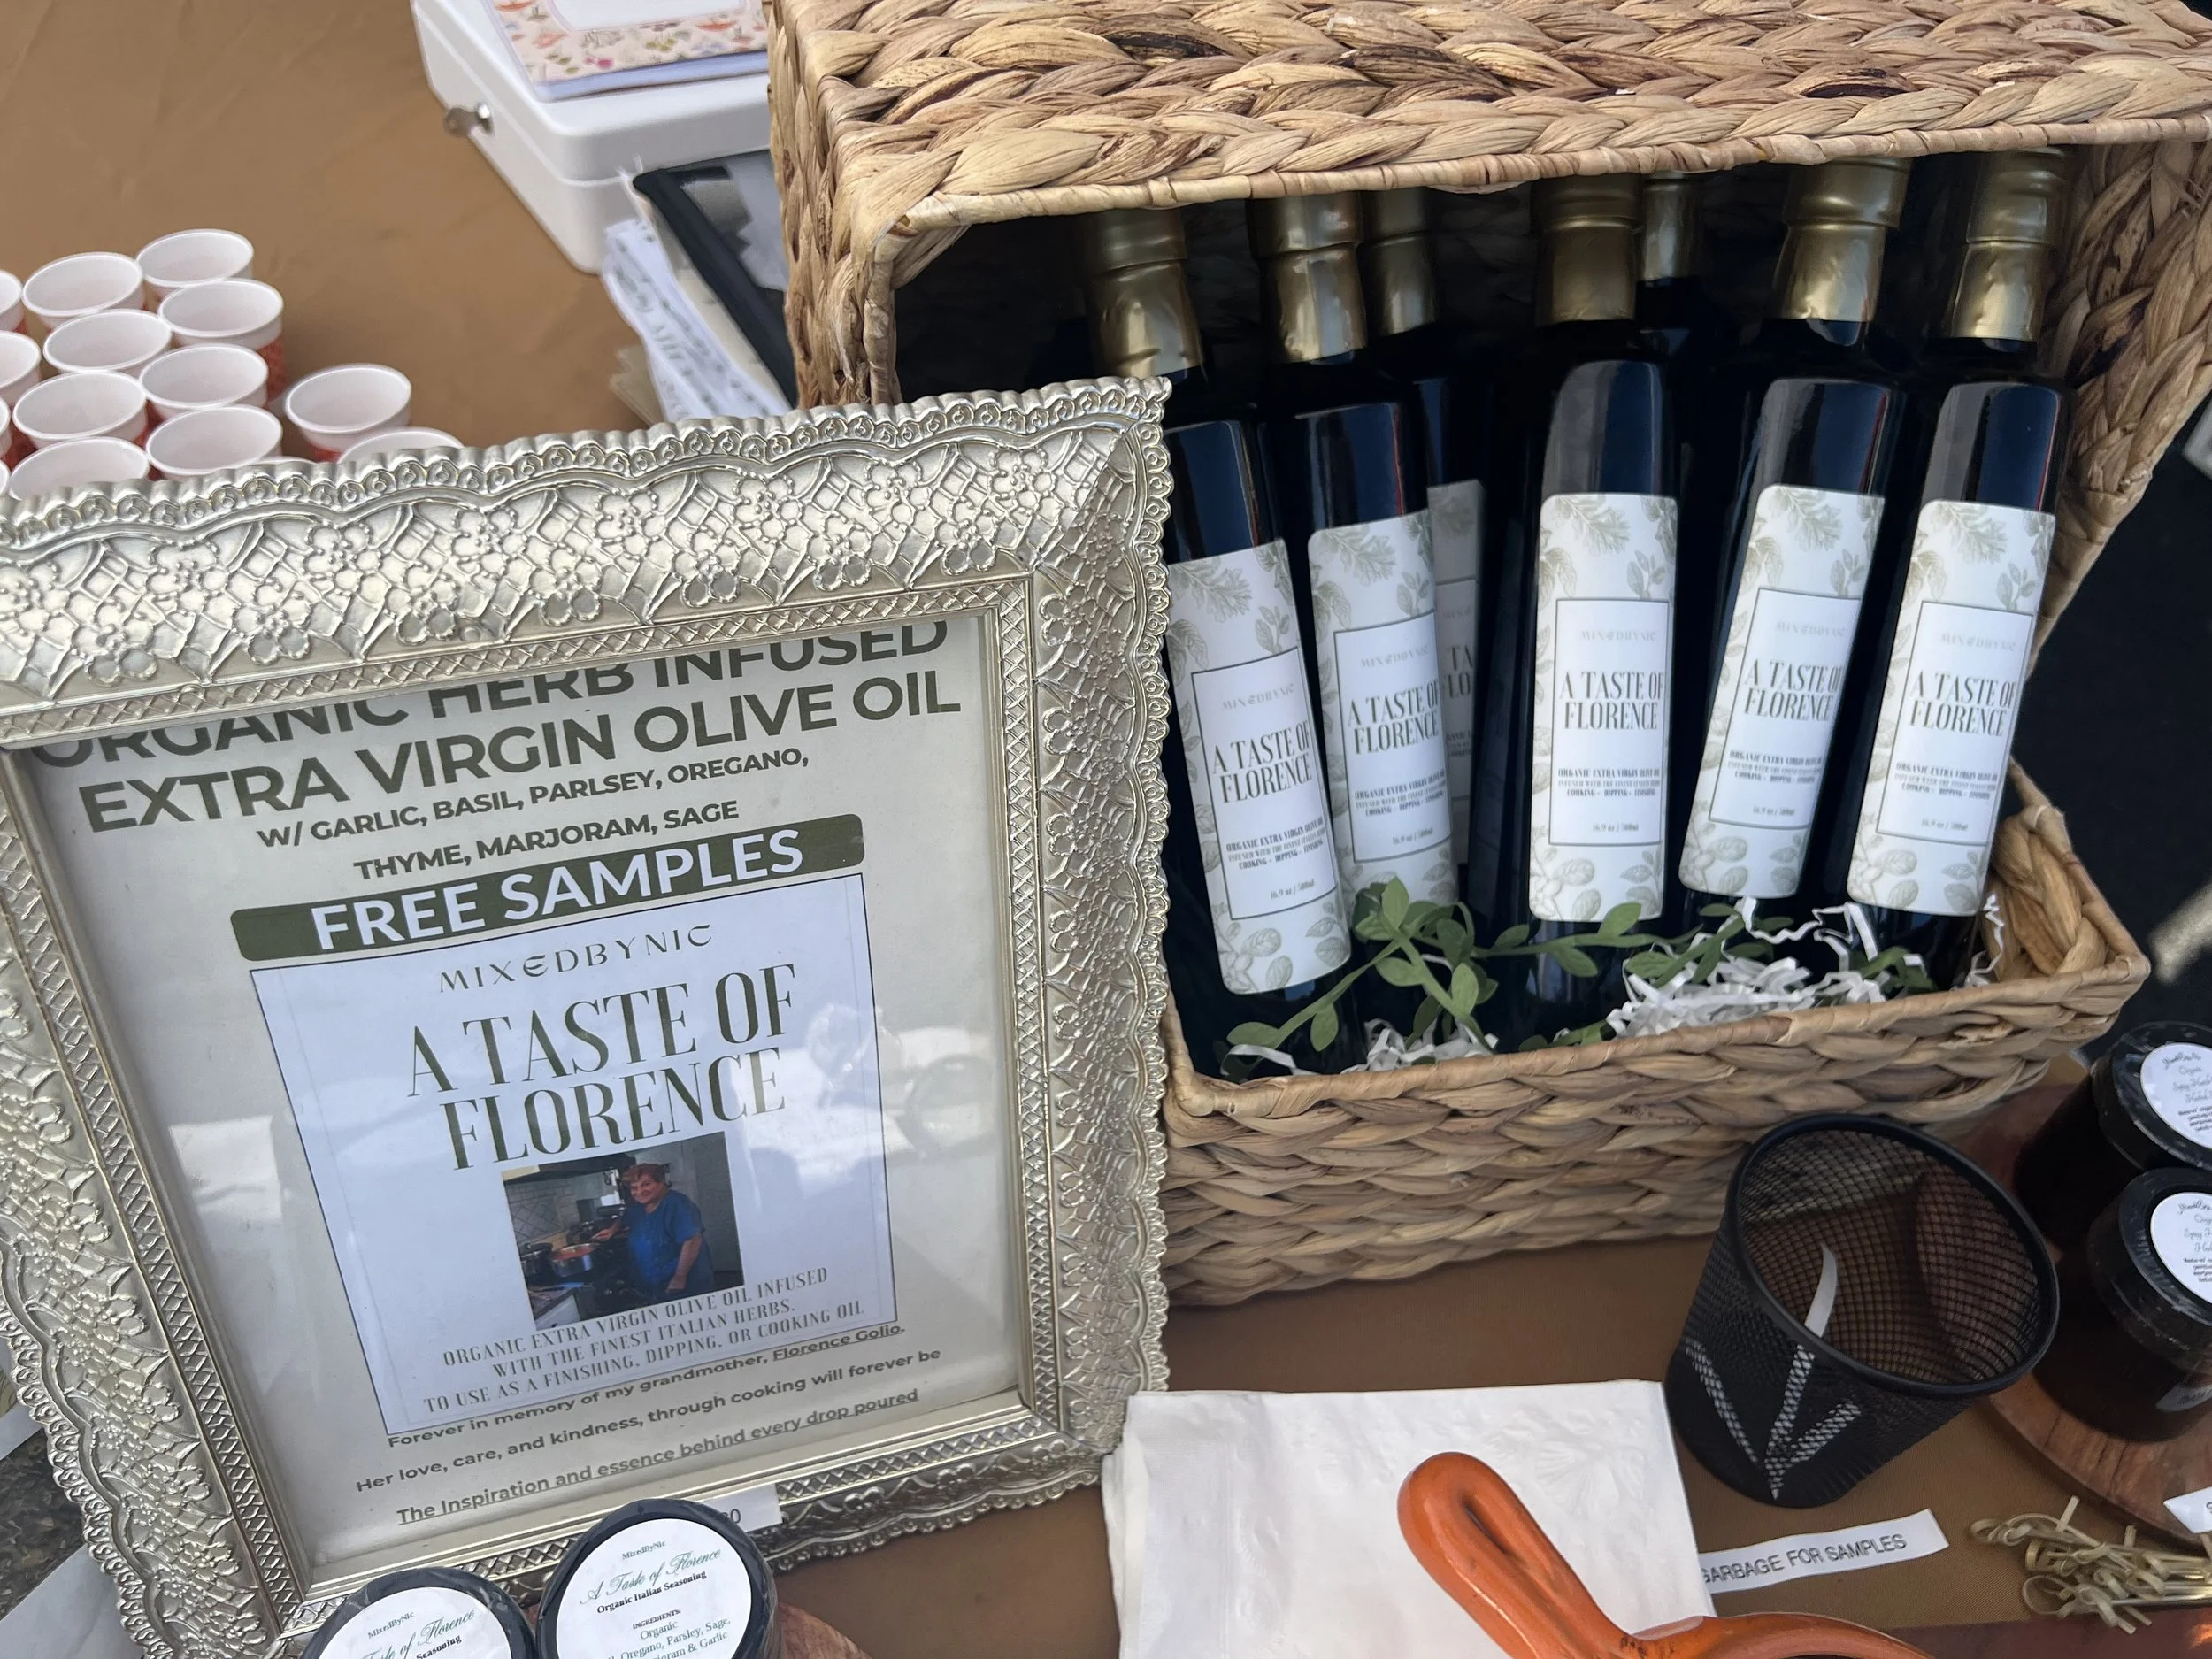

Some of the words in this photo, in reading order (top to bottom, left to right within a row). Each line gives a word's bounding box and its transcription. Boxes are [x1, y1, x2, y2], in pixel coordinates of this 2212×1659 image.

[31, 700, 409, 768] ORGANIC
[427, 664, 634, 718] HERB
[655, 621, 949, 687] INFUSED
[1559, 672, 1573, 699] A
[1581, 672, 1644, 700] TASTE
[1649, 672, 1663, 700] OF
[1745, 658, 1758, 686] A
[1770, 659, 1828, 692] TASTE
[1910, 670, 1923, 697] A
[1935, 672, 1999, 706] TASTE
[2000, 680, 2016, 709] OF
[1348, 700, 1361, 726] A
[1366, 687, 1424, 723] TASTE
[1426, 679, 1438, 709] OF
[1565, 702, 1657, 729] FLORENCE
[1745, 687, 1833, 721] FLORENCE
[1911, 701, 2007, 736] FLORENCE
[79, 757, 350, 833] EXTRA
[355, 714, 616, 795] VIRGIN
[634, 684, 838, 753] OLIVE
[853, 671, 961, 720] OIL
[1213, 746, 1226, 773] A
[1231, 729, 1294, 771] TASTE
[1296, 720, 1310, 749] OF
[1355, 710, 1438, 754] FLORENCE
[257, 821, 303, 847] W/
[311, 806, 427, 840] GARLIC,
[433, 790, 524, 821] BASIL,
[529, 769, 662, 804] PARLSEY,
[667, 748, 809, 784] OREGANO,
[1220, 753, 1312, 803] FLORENCE
[353, 844, 472, 879] THYME,
[476, 814, 657, 860] MARJORAM,
[664, 800, 740, 829] SAGE
[311, 883, 486, 949] FREE
[500, 829, 803, 920] SAMPLES
[407, 1026, 459, 1097] A
[463, 983, 696, 1085] TASTE
[715, 963, 795, 1044] OF
[439, 1047, 785, 1171] FLORENCE
[442, 1338, 526, 1366] ORGANIC
[531, 1325, 590, 1349] EXTRA
[596, 1308, 659, 1334] VIRGIN
[665, 1295, 717, 1318] OLIVE
[723, 1287, 751, 1306] OIL
[757, 1267, 827, 1298] INFUSED
[493, 1356, 541, 1378] WITH
[547, 1347, 584, 1366] THE
[591, 1330, 651, 1357] FINEST
[659, 1314, 726, 1341] ITALIAN
[734, 1299, 795, 1323] HERBS.
[423, 1395, 449, 1413] TO
[456, 1386, 490, 1407] USE
[496, 1381, 519, 1398] AS
[526, 1379, 538, 1393] A
[729, 1329, 751, 1344] OR
[759, 1310, 830, 1338] COOKING
[837, 1300, 864, 1319] OIL
[388, 1425, 465, 1448] Forever
[470, 1419, 488, 1430] in
[495, 1400, 575, 1426] memory
[581, 1392, 600, 1405] of
[605, 1385, 634, 1400] my
[640, 1354, 768, 1393] grandmother,
[772, 1334, 850, 1361] Florence
[357, 1473, 394, 1493] Her
[399, 1463, 448, 1480] love,
[453, 1448, 503, 1467] care,
[508, 1437, 545, 1455] and
[551, 1416, 644, 1446] kindness,
[648, 1395, 726, 1423] through
[731, 1378, 806, 1403] cooking
[811, 1369, 843, 1385] will
[849, 1356, 913, 1378] forever
[918, 1350, 941, 1362] be
[396, 1505, 435, 1525] The
[442, 1477, 549, 1515] Inspiration
[556, 1465, 593, 1488] and
[598, 1448, 675, 1479] essence
[680, 1429, 745, 1458] behind
[751, 1416, 801, 1441] every
[807, 1408, 849, 1427] drop
[854, 1388, 919, 1417] poured
[622, 1540, 665, 1559] MixedByNic
[1787, 1548, 1824, 1567] FOR
[1827, 1534, 1907, 1561] SAMPLES
[580, 1580, 603, 1604] A
[606, 1571, 646, 1595] Taste
[649, 1562, 665, 1586] of
[666, 1549, 721, 1576] Florence
[597, 1598, 632, 1614] Organic
[634, 1587, 662, 1601] Italian
[664, 1571, 707, 1590] Seasoning
[400, 1632, 416, 1659] of
[418, 1610, 474, 1644] Florence
[417, 1635, 462, 1659] Seasoning
[621, 1642, 664, 1659] Oregano,
[666, 1628, 703, 1646] Parsley,
[705, 1617, 731, 1632] Sage,
[641, 1621, 678, 1640] Organic
[688, 1643, 697, 1653] &
[700, 1632, 727, 1647] Garlic
